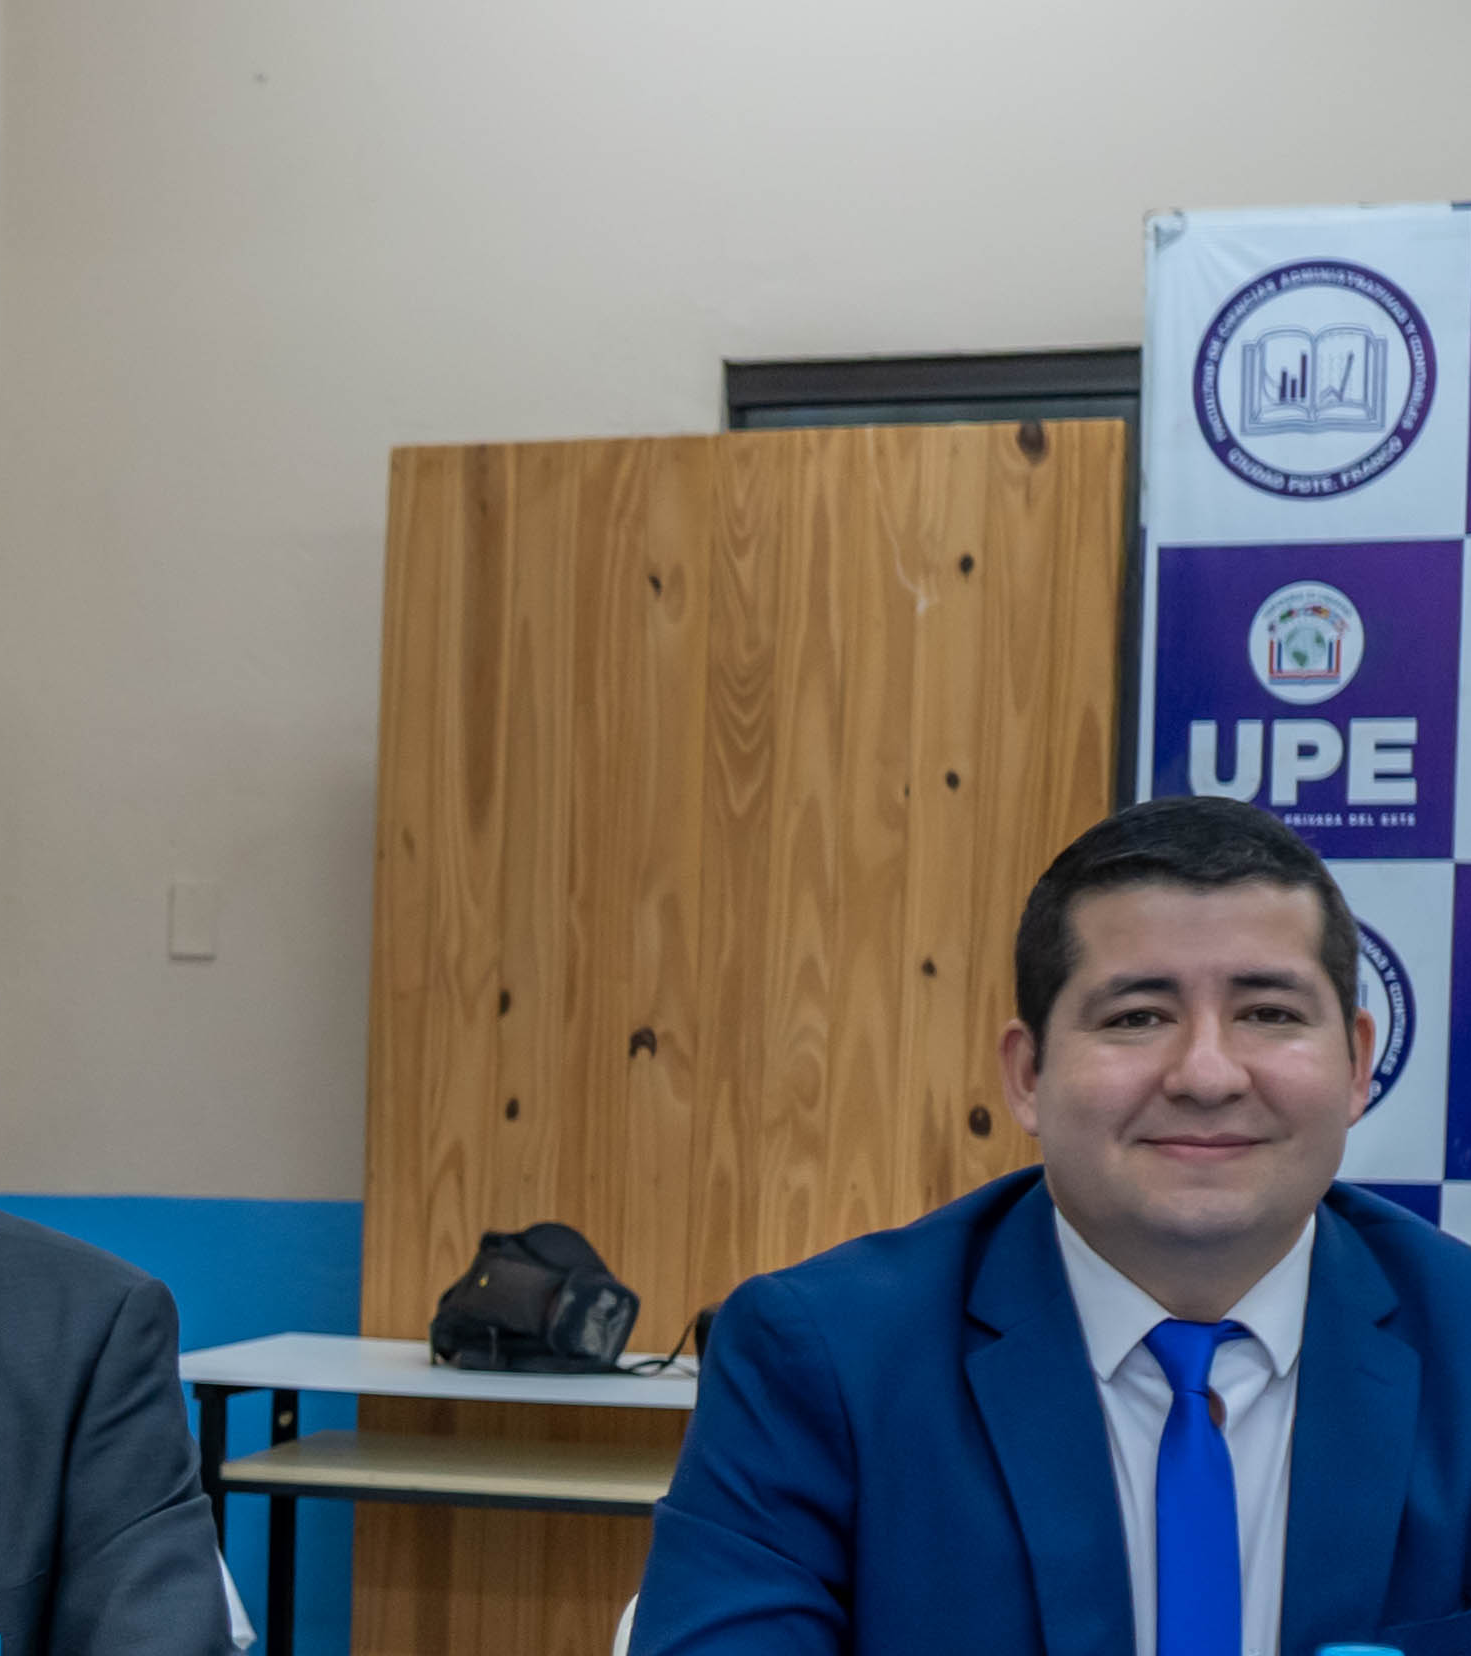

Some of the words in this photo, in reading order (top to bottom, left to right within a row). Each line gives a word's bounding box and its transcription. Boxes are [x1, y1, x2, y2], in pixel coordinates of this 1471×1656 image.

[1217, 280, 1276, 337] CIENCIAS
[1279, 268, 1410, 322] ADMINISTRATIVAS
[1227, 447, 1285, 488] CIUDAD
[1340, 435, 1402, 485] FRANCO
[1189, 718, 1417, 807] UPE
[1349, 814, 1374, 826] DEL
[1380, 814, 1415, 825] ESTE
